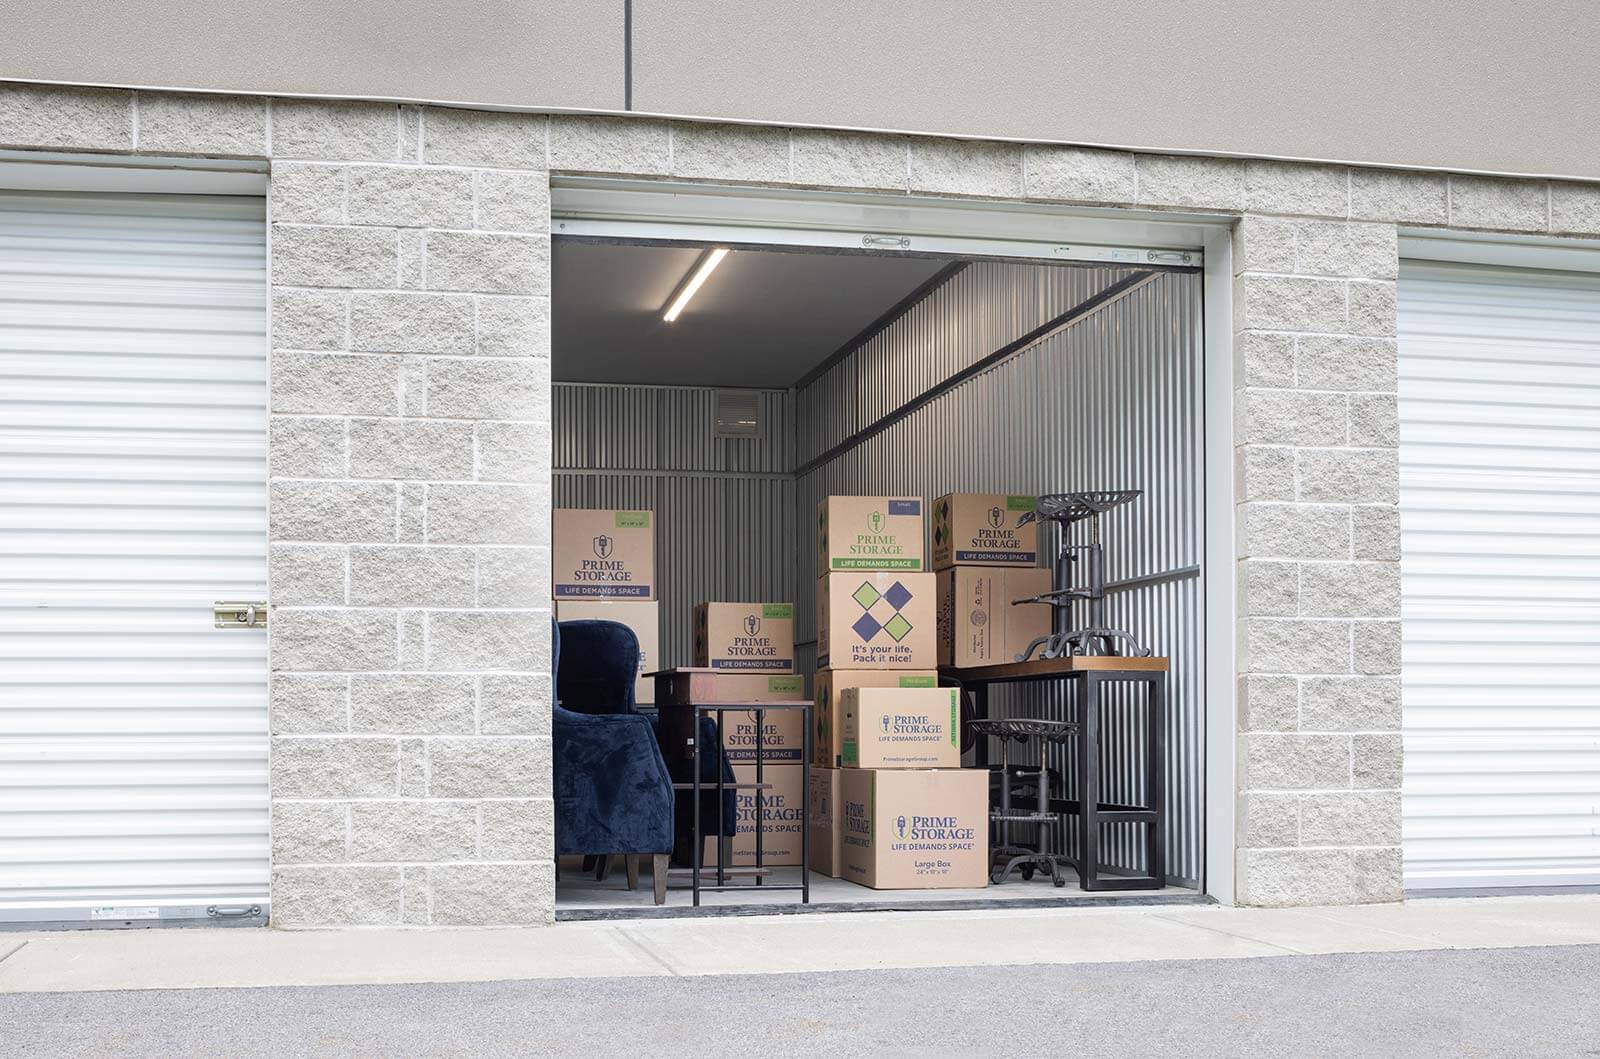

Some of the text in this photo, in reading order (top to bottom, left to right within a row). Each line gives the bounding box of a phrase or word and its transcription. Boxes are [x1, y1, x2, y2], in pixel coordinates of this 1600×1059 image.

[979, 529, 1014, 539] PRIME
[857, 535, 896, 545] PRIME
[972, 538, 1021, 548] STORAGE
[849, 545, 903, 555] STORAGE
[581, 560, 624, 571] PRIME
[574, 571, 632, 581] STORAGE
[565, 586, 581, 594] LIFE
[734, 638, 770, 646] PRIME
[727, 647, 777, 656] STORAGE
[852, 645, 913, 654] It's your life.
[853, 654, 912, 662] Pack it nice!
[894, 715, 929, 725] PRIME
[893, 724, 942, 734] STORAGE
[728, 735, 785, 745] STORAGE
[735, 795, 785, 807] PRME
[911, 816, 957, 828] PRIME
[911, 828, 975, 840] STORAGE
[914, 860, 951, 869] Large Box
